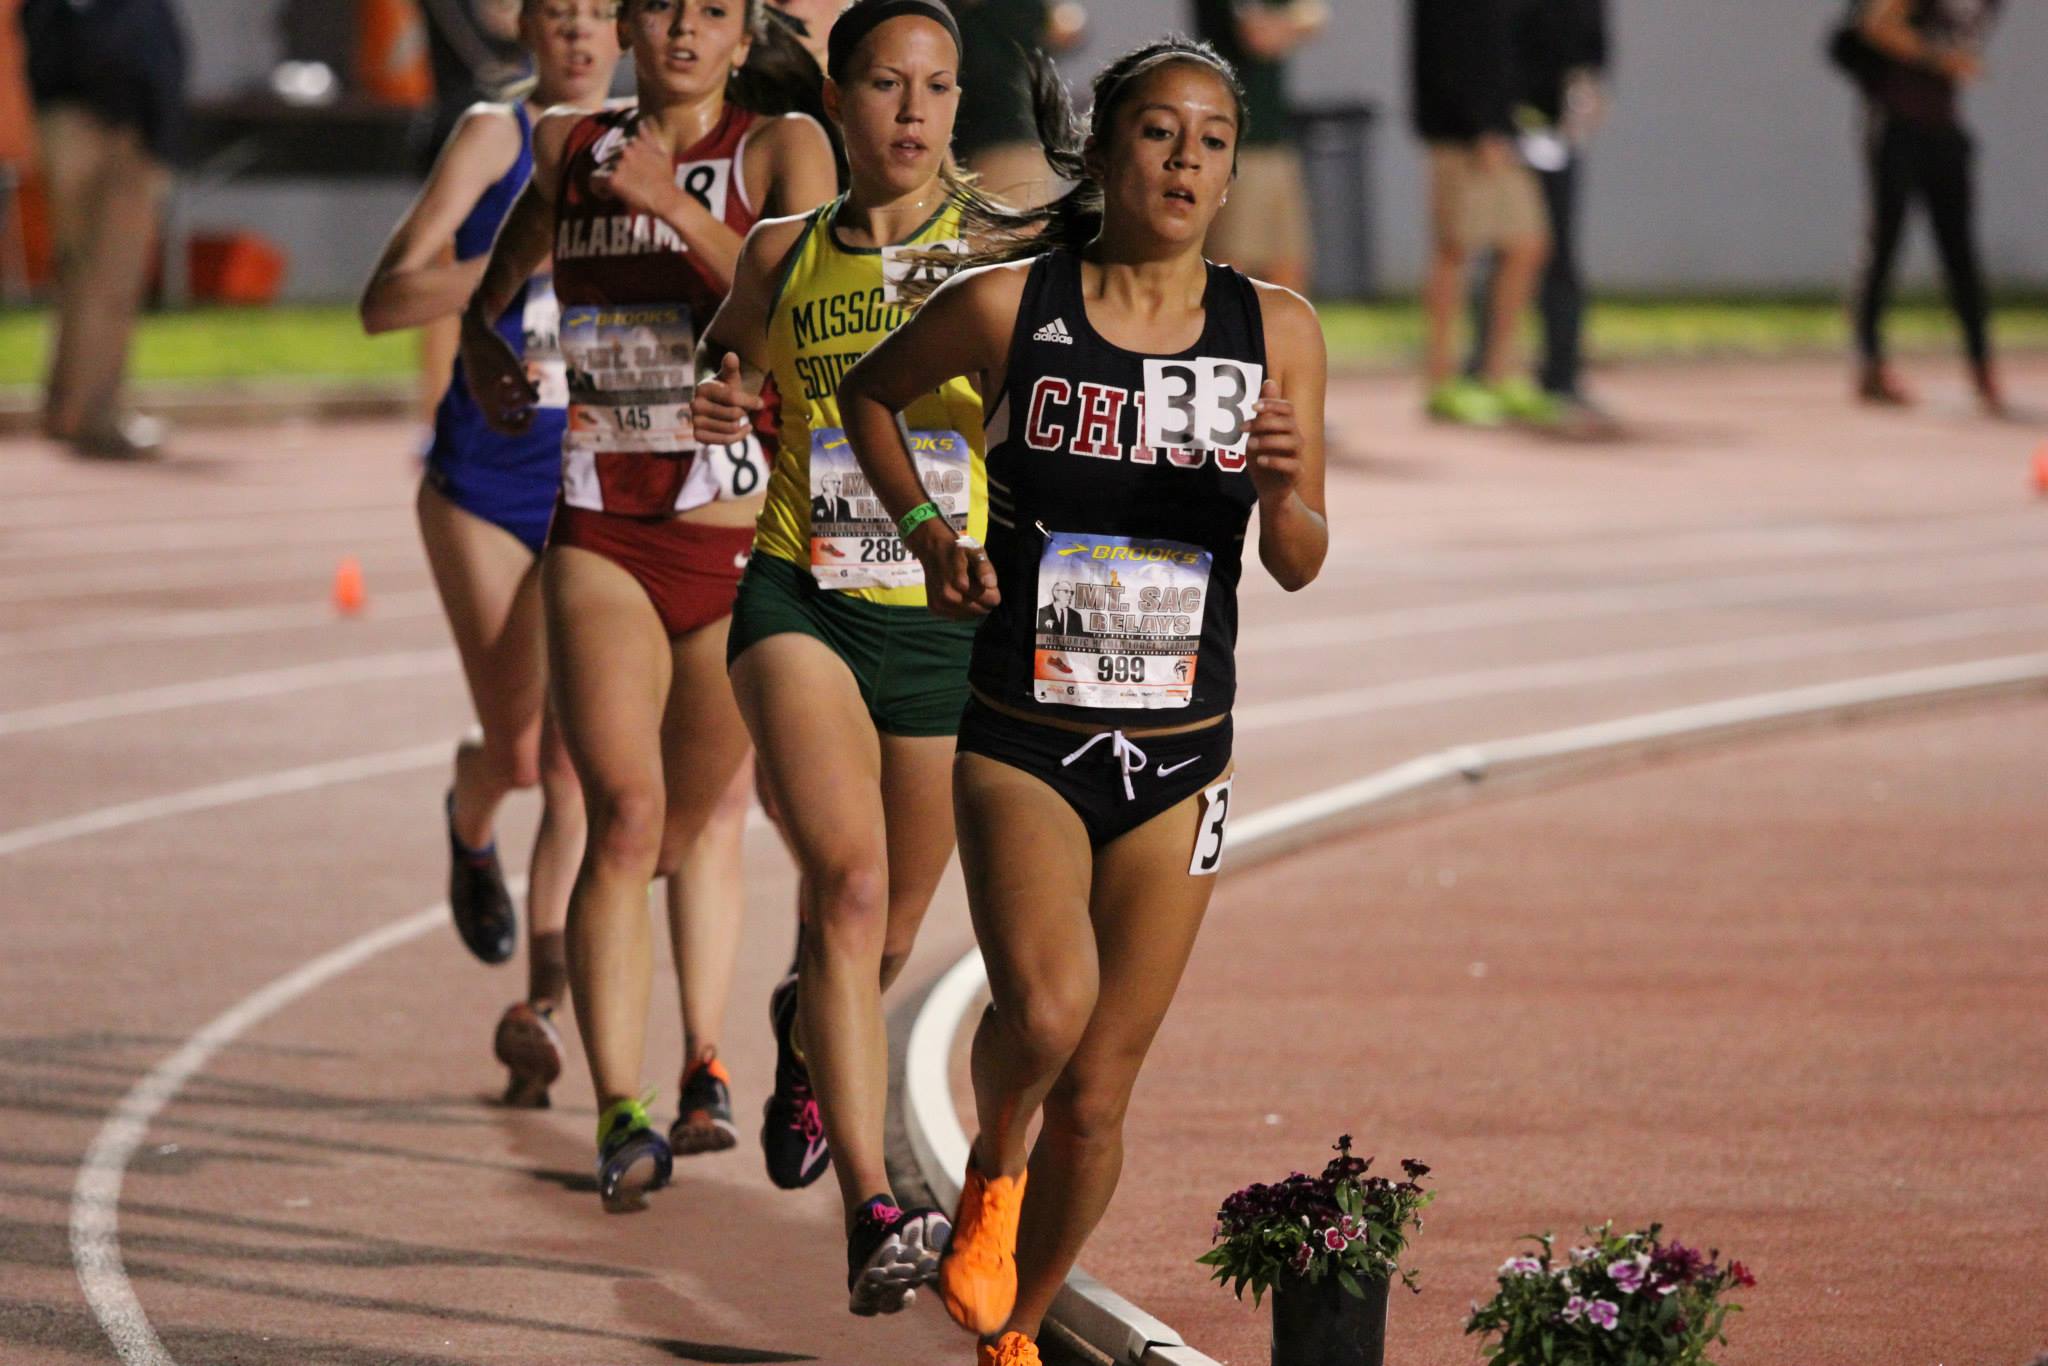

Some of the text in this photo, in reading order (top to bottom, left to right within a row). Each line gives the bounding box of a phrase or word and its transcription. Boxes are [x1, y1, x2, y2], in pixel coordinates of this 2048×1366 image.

[556, 214, 689, 260] ALABAM
[792, 287, 902, 349] MISSOU
[1033, 332, 1073, 345] adidas
[615, 407, 651, 431] 145
[1025, 375, 1247, 472] CHI
[725, 441, 759, 496] 8
[860, 538, 918, 563] 286
[1092, 545, 1200, 565] BROOKS
[1075, 582, 1201, 613] MT. SAC
[1089, 612, 1191, 634] RELAYS
[1097, 655, 1145, 683] 999
[1201, 788, 1229, 870] 3
